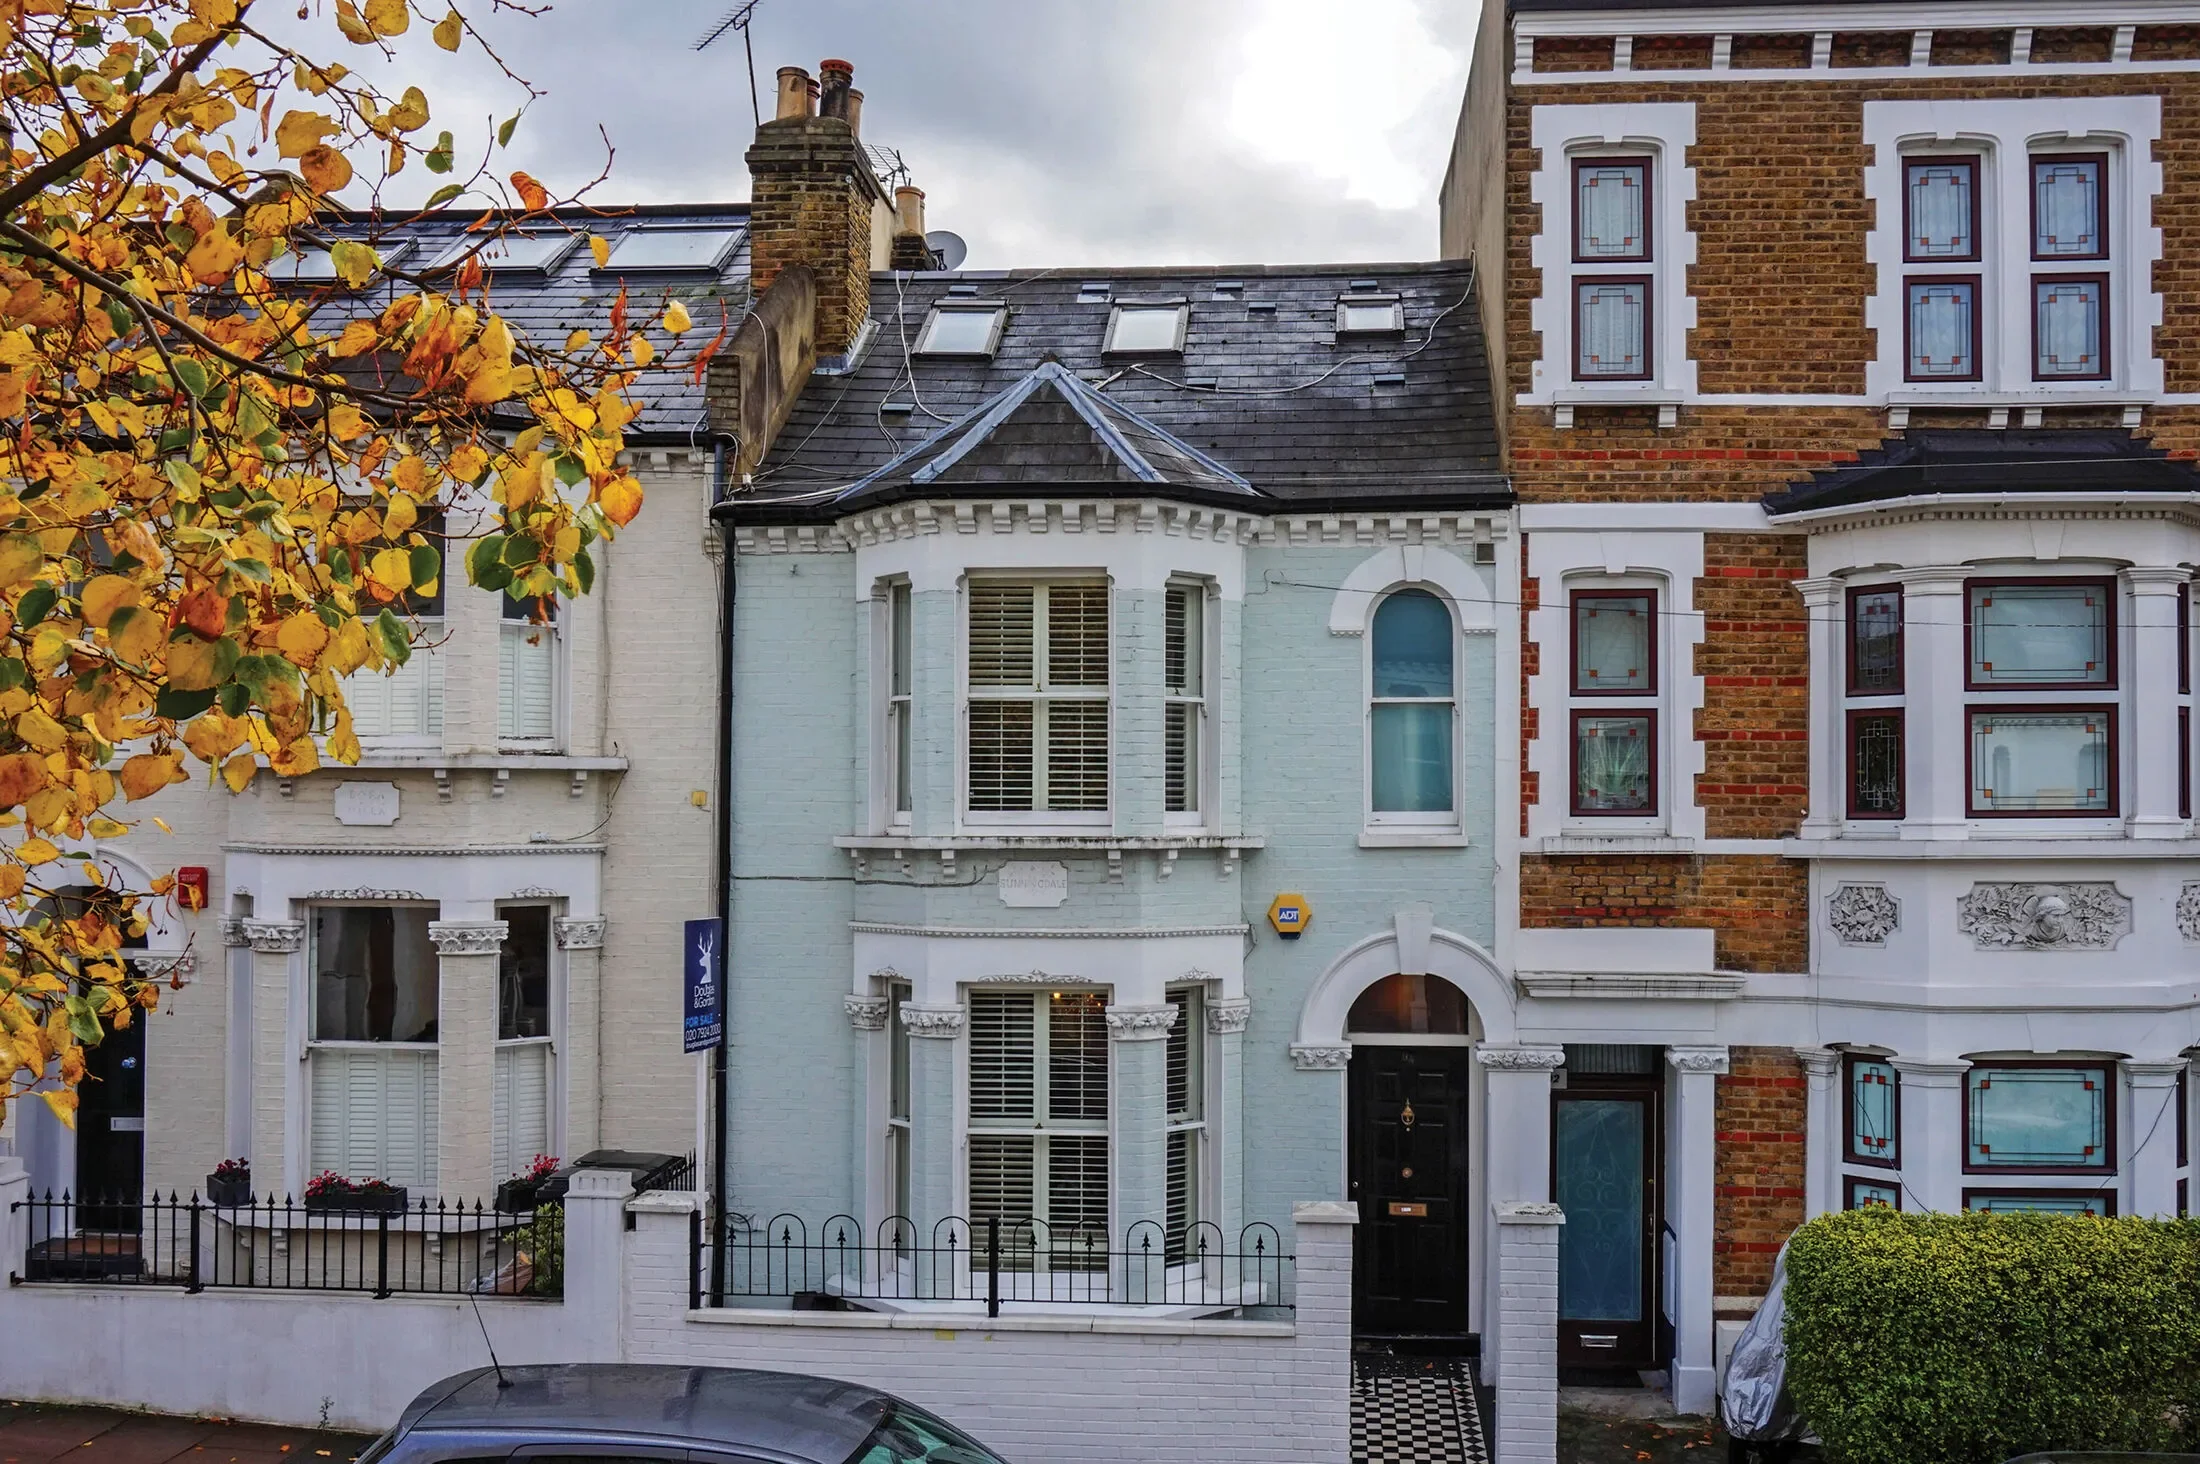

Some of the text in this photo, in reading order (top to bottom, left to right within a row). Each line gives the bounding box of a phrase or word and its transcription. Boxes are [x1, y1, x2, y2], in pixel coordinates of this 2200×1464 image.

[1279, 910, 1298, 920] ADT
[693, 984, 715, 997] Douglas
[685, 1013, 713, 1029] FOR SALE
[685, 1028, 697, 1042] 020
